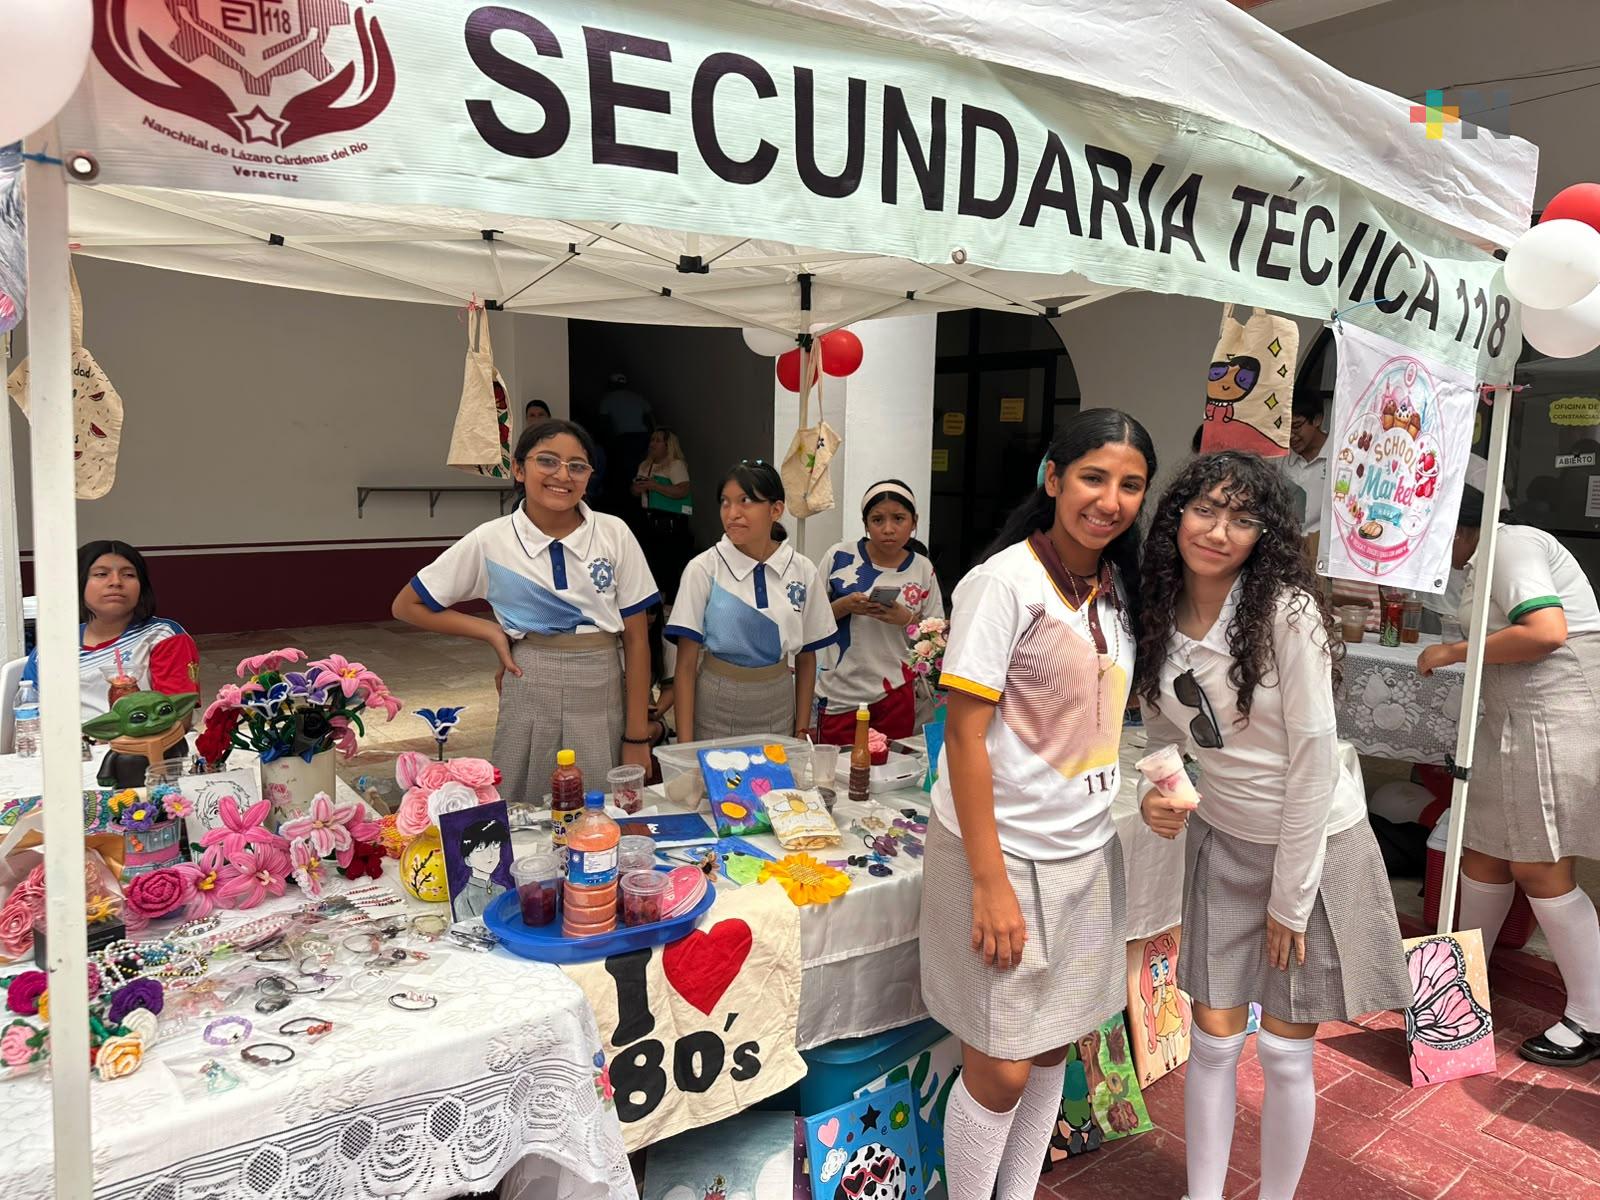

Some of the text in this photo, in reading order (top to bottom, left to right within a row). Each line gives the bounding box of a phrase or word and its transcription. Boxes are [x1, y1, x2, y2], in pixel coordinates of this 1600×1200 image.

[265, 7, 292, 35] 118
[142, 116, 209, 150] Nanchital
[211, 143, 228, 156] de
[231, 148, 272, 164] Lázaro
[275, 153, 329, 166] Cárdenas
[331, 147, 349, 160] del
[233, 165, 299, 182] Veracruz
[464, 5, 1205, 264] SECUNDARIA
[1454, 278, 1510, 358] 118
[1374, 436, 1417, 474] SCHOOL
[1559, 455, 1592, 465] ABIERTO
[1358, 464, 1416, 507] Market
[604, 948, 655, 1047] I
